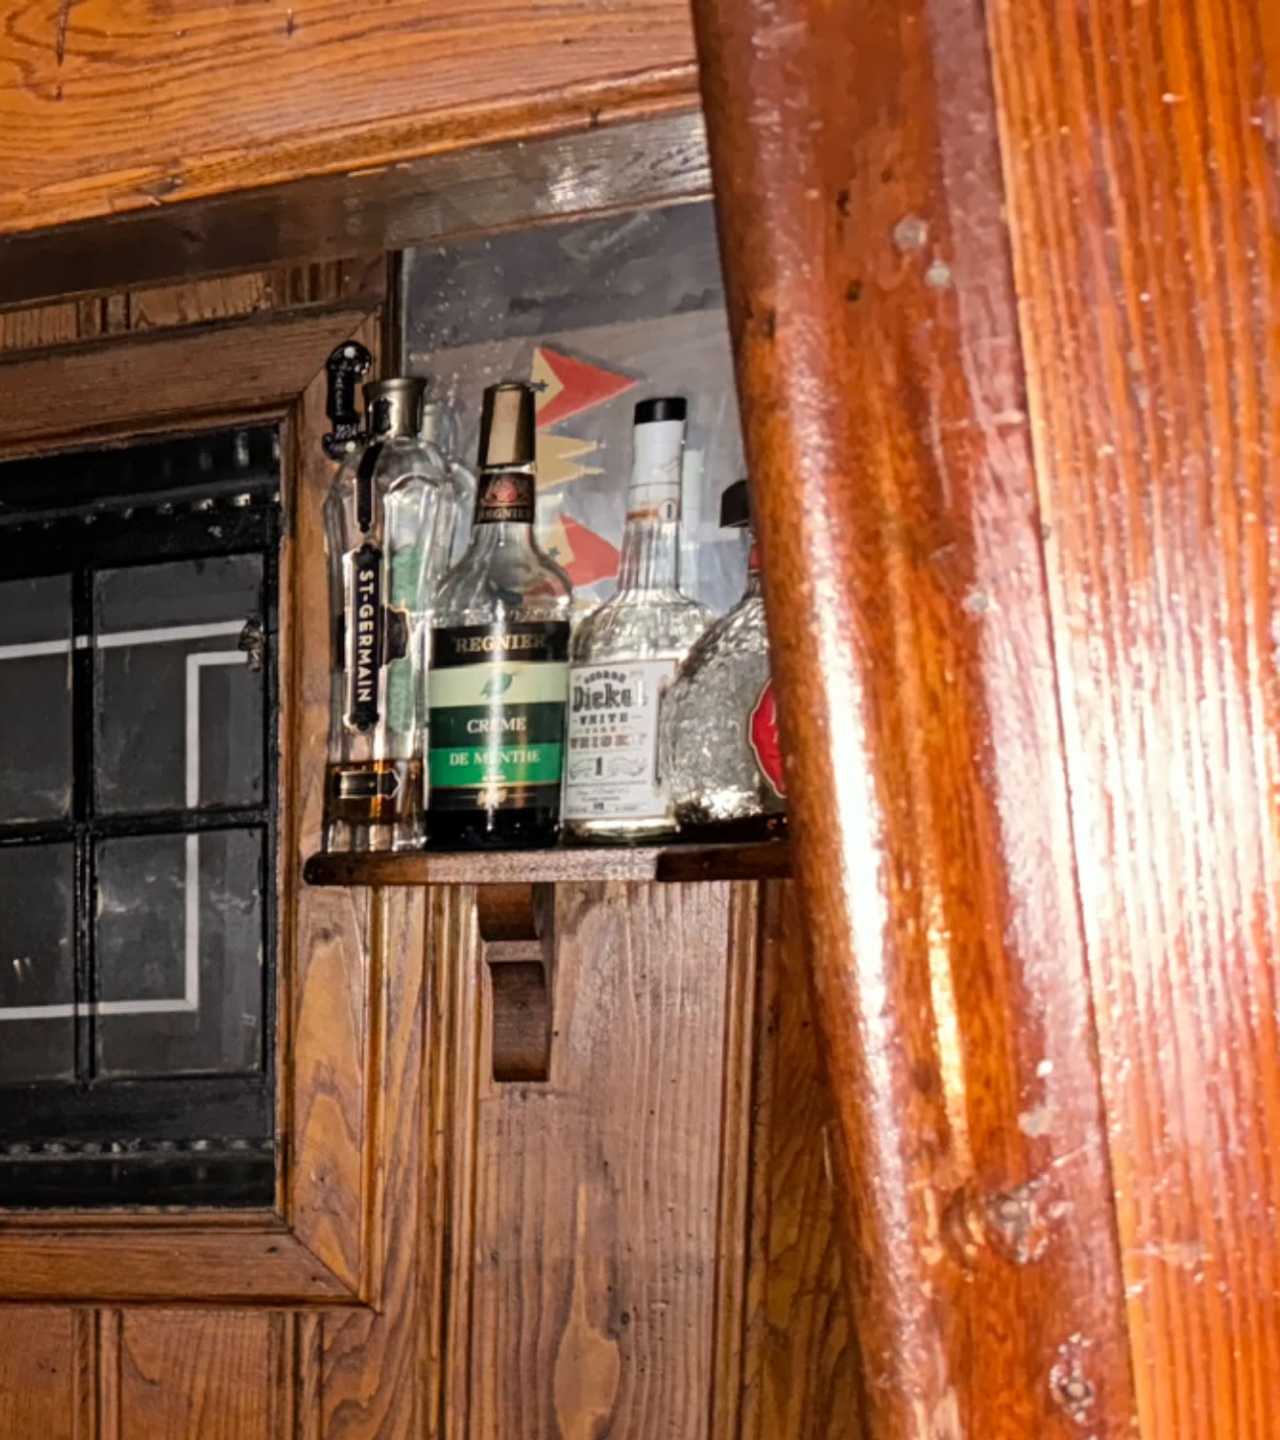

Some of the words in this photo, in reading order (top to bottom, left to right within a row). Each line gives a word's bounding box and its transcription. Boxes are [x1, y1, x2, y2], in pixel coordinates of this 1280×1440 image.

[358, 568, 375, 703] ST-GERMAIN
[455, 632, 548, 653] REGNIER
[466, 716, 527, 734] CRME
[449, 750, 470, 766] DE
[473, 749, 541, 765] MNTHE
